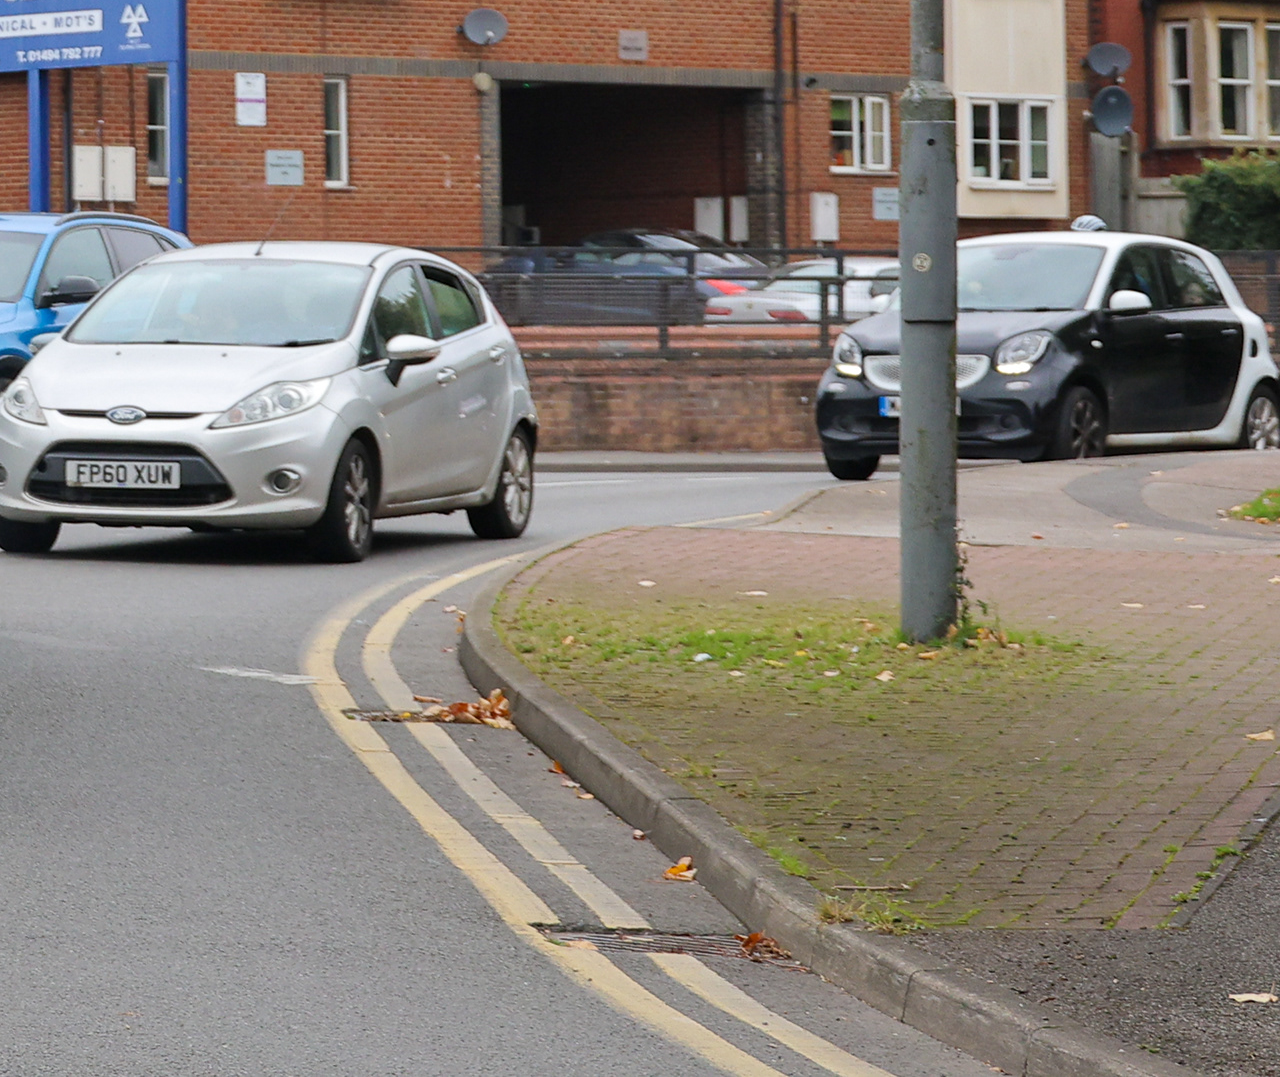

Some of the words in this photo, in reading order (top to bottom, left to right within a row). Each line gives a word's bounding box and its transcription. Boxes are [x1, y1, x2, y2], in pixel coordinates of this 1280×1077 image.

[82, 45, 103, 59] 777
[77, 463, 127, 484] FP60
[134, 464, 173, 484] XUW
